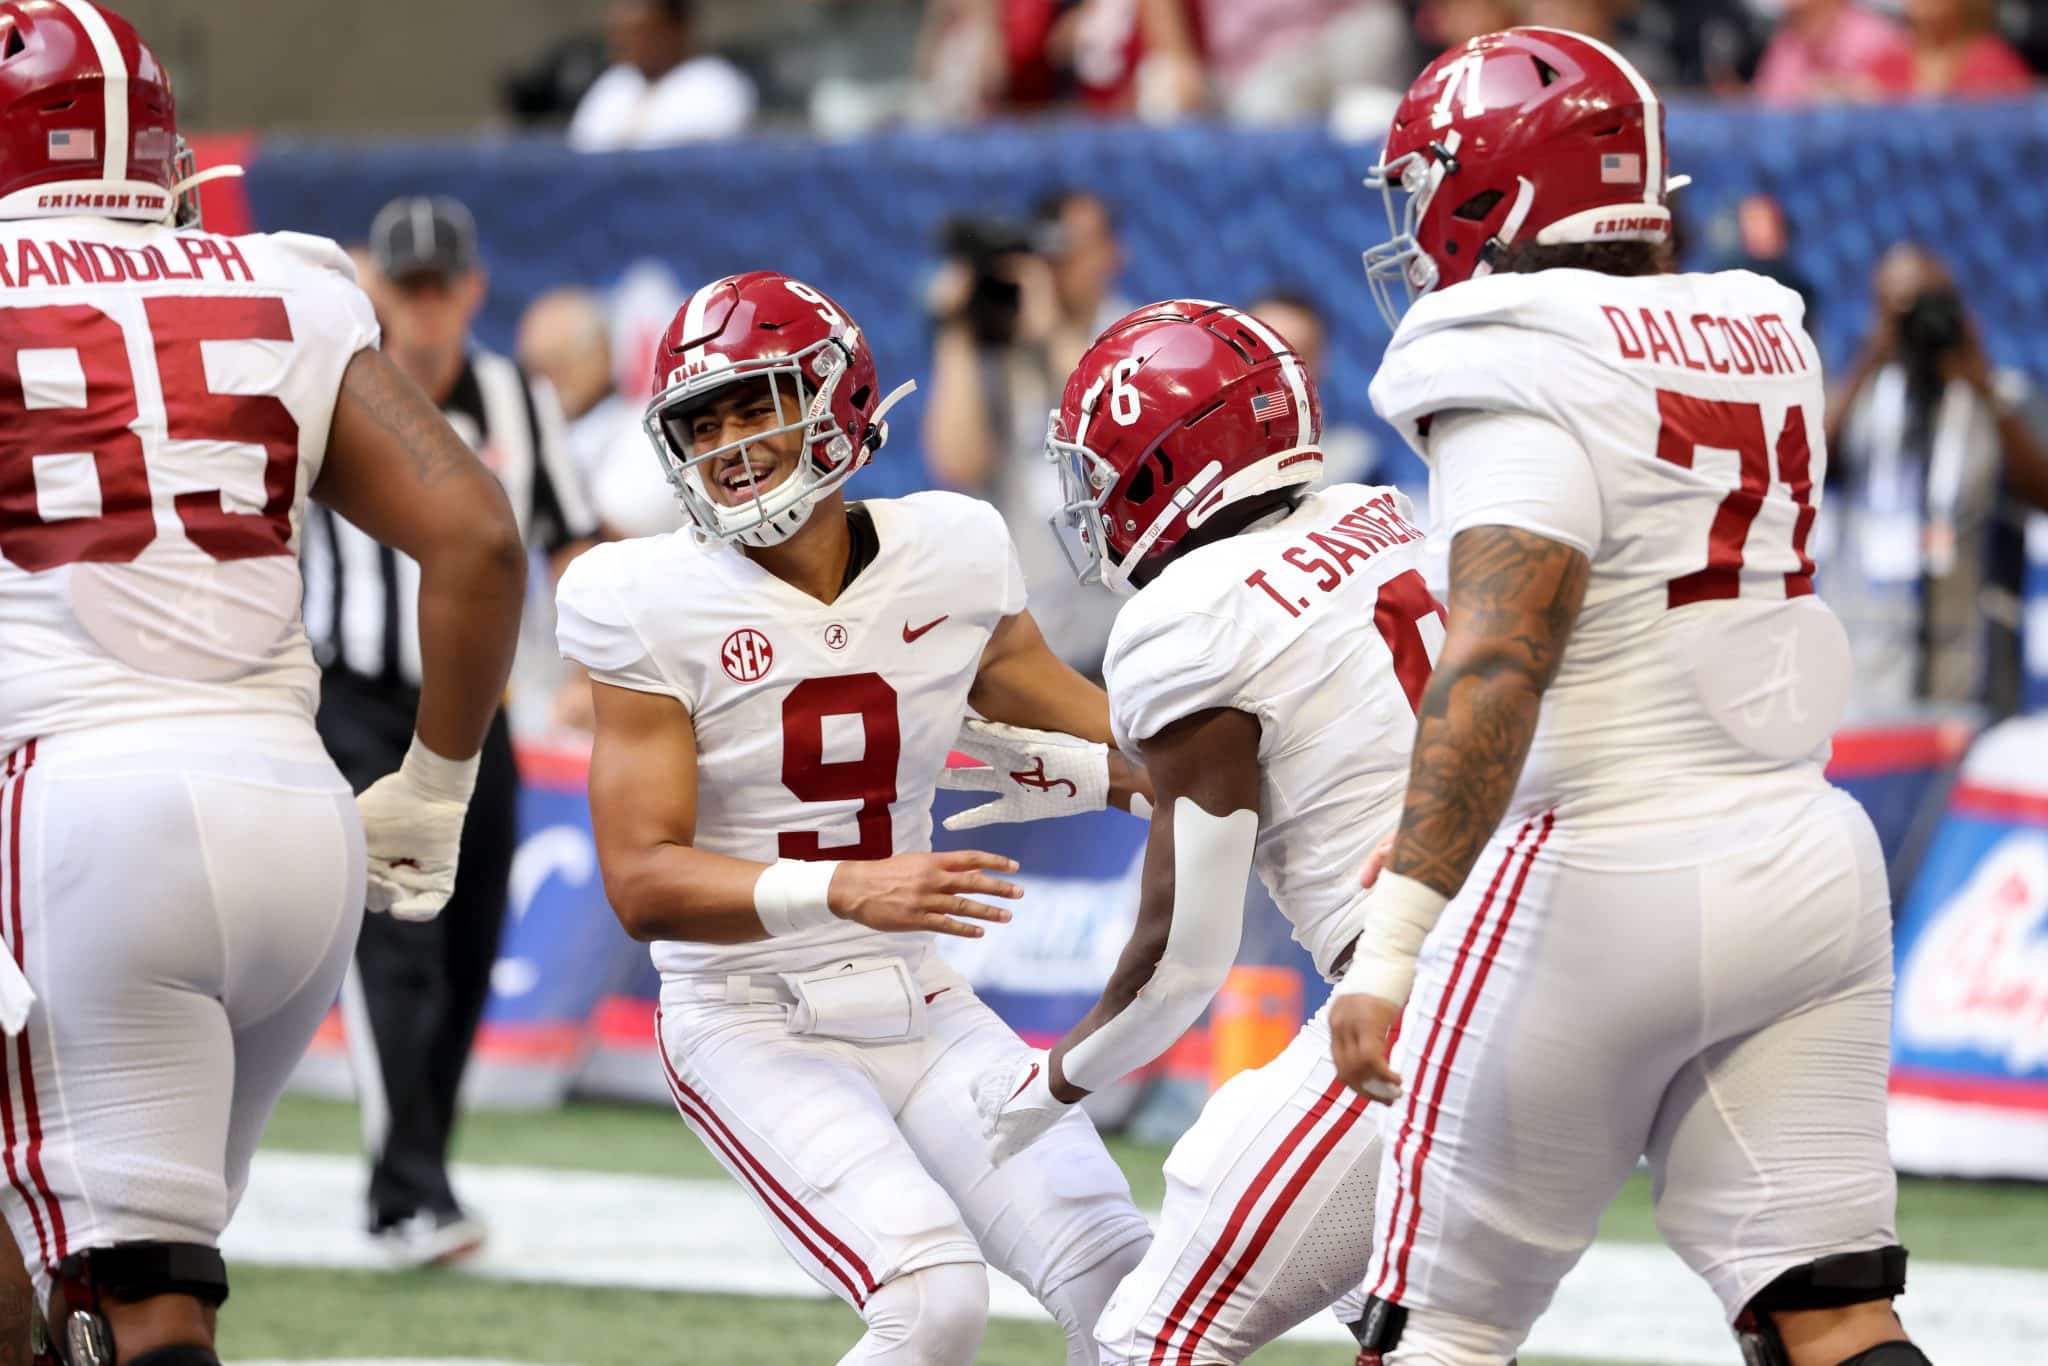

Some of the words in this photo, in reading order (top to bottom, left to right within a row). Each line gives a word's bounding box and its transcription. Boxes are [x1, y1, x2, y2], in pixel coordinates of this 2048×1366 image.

[1432, 50, 1485, 129] 71
[38, 194, 130, 209] CRIMSON
[784, 281, 841, 325] 9
[674, 360, 709, 383] BAMA
[1600, 305, 1807, 375] DALCOURT
[1110, 358, 1142, 426] 6
[0, 296, 299, 573] 85
[1655, 388, 1816, 610] 71
[1244, 568, 1311, 618] T.
[722, 629, 772, 681] SEC
[777, 672, 901, 861] 9
